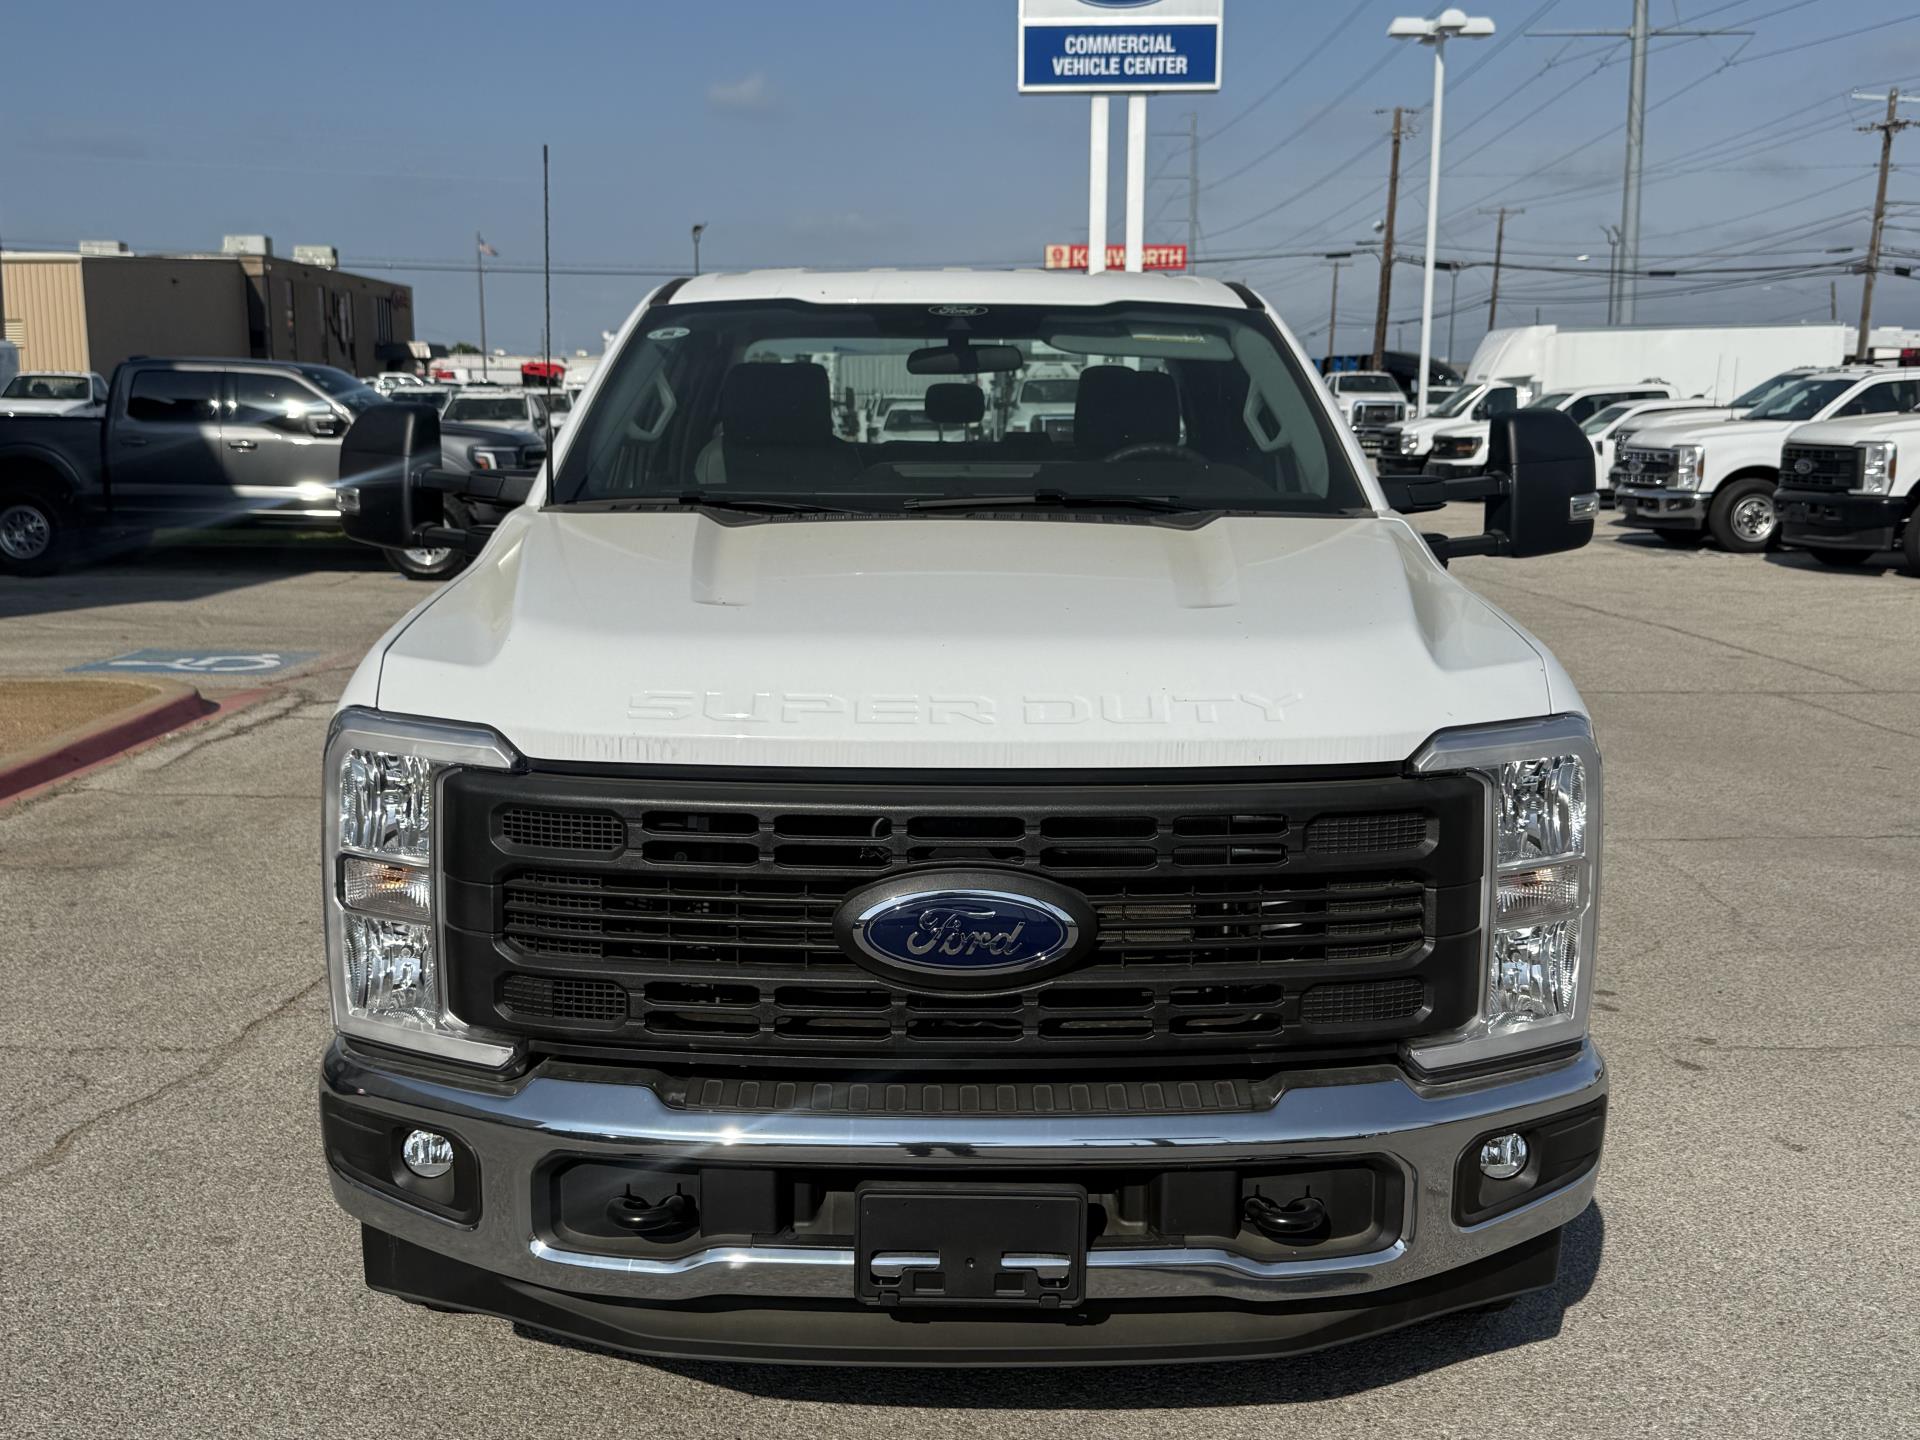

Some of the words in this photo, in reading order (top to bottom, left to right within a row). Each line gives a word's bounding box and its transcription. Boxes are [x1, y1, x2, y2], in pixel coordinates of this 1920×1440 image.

[1064, 34, 1176, 54] COMMERCIAL
[1052, 56, 1120, 76] VEHICLE
[1123, 56, 1188, 75] CENTER
[627, 690, 996, 724] SUPER
[1022, 693, 1303, 725] DUTY
[907, 907, 1026, 956] Ford
